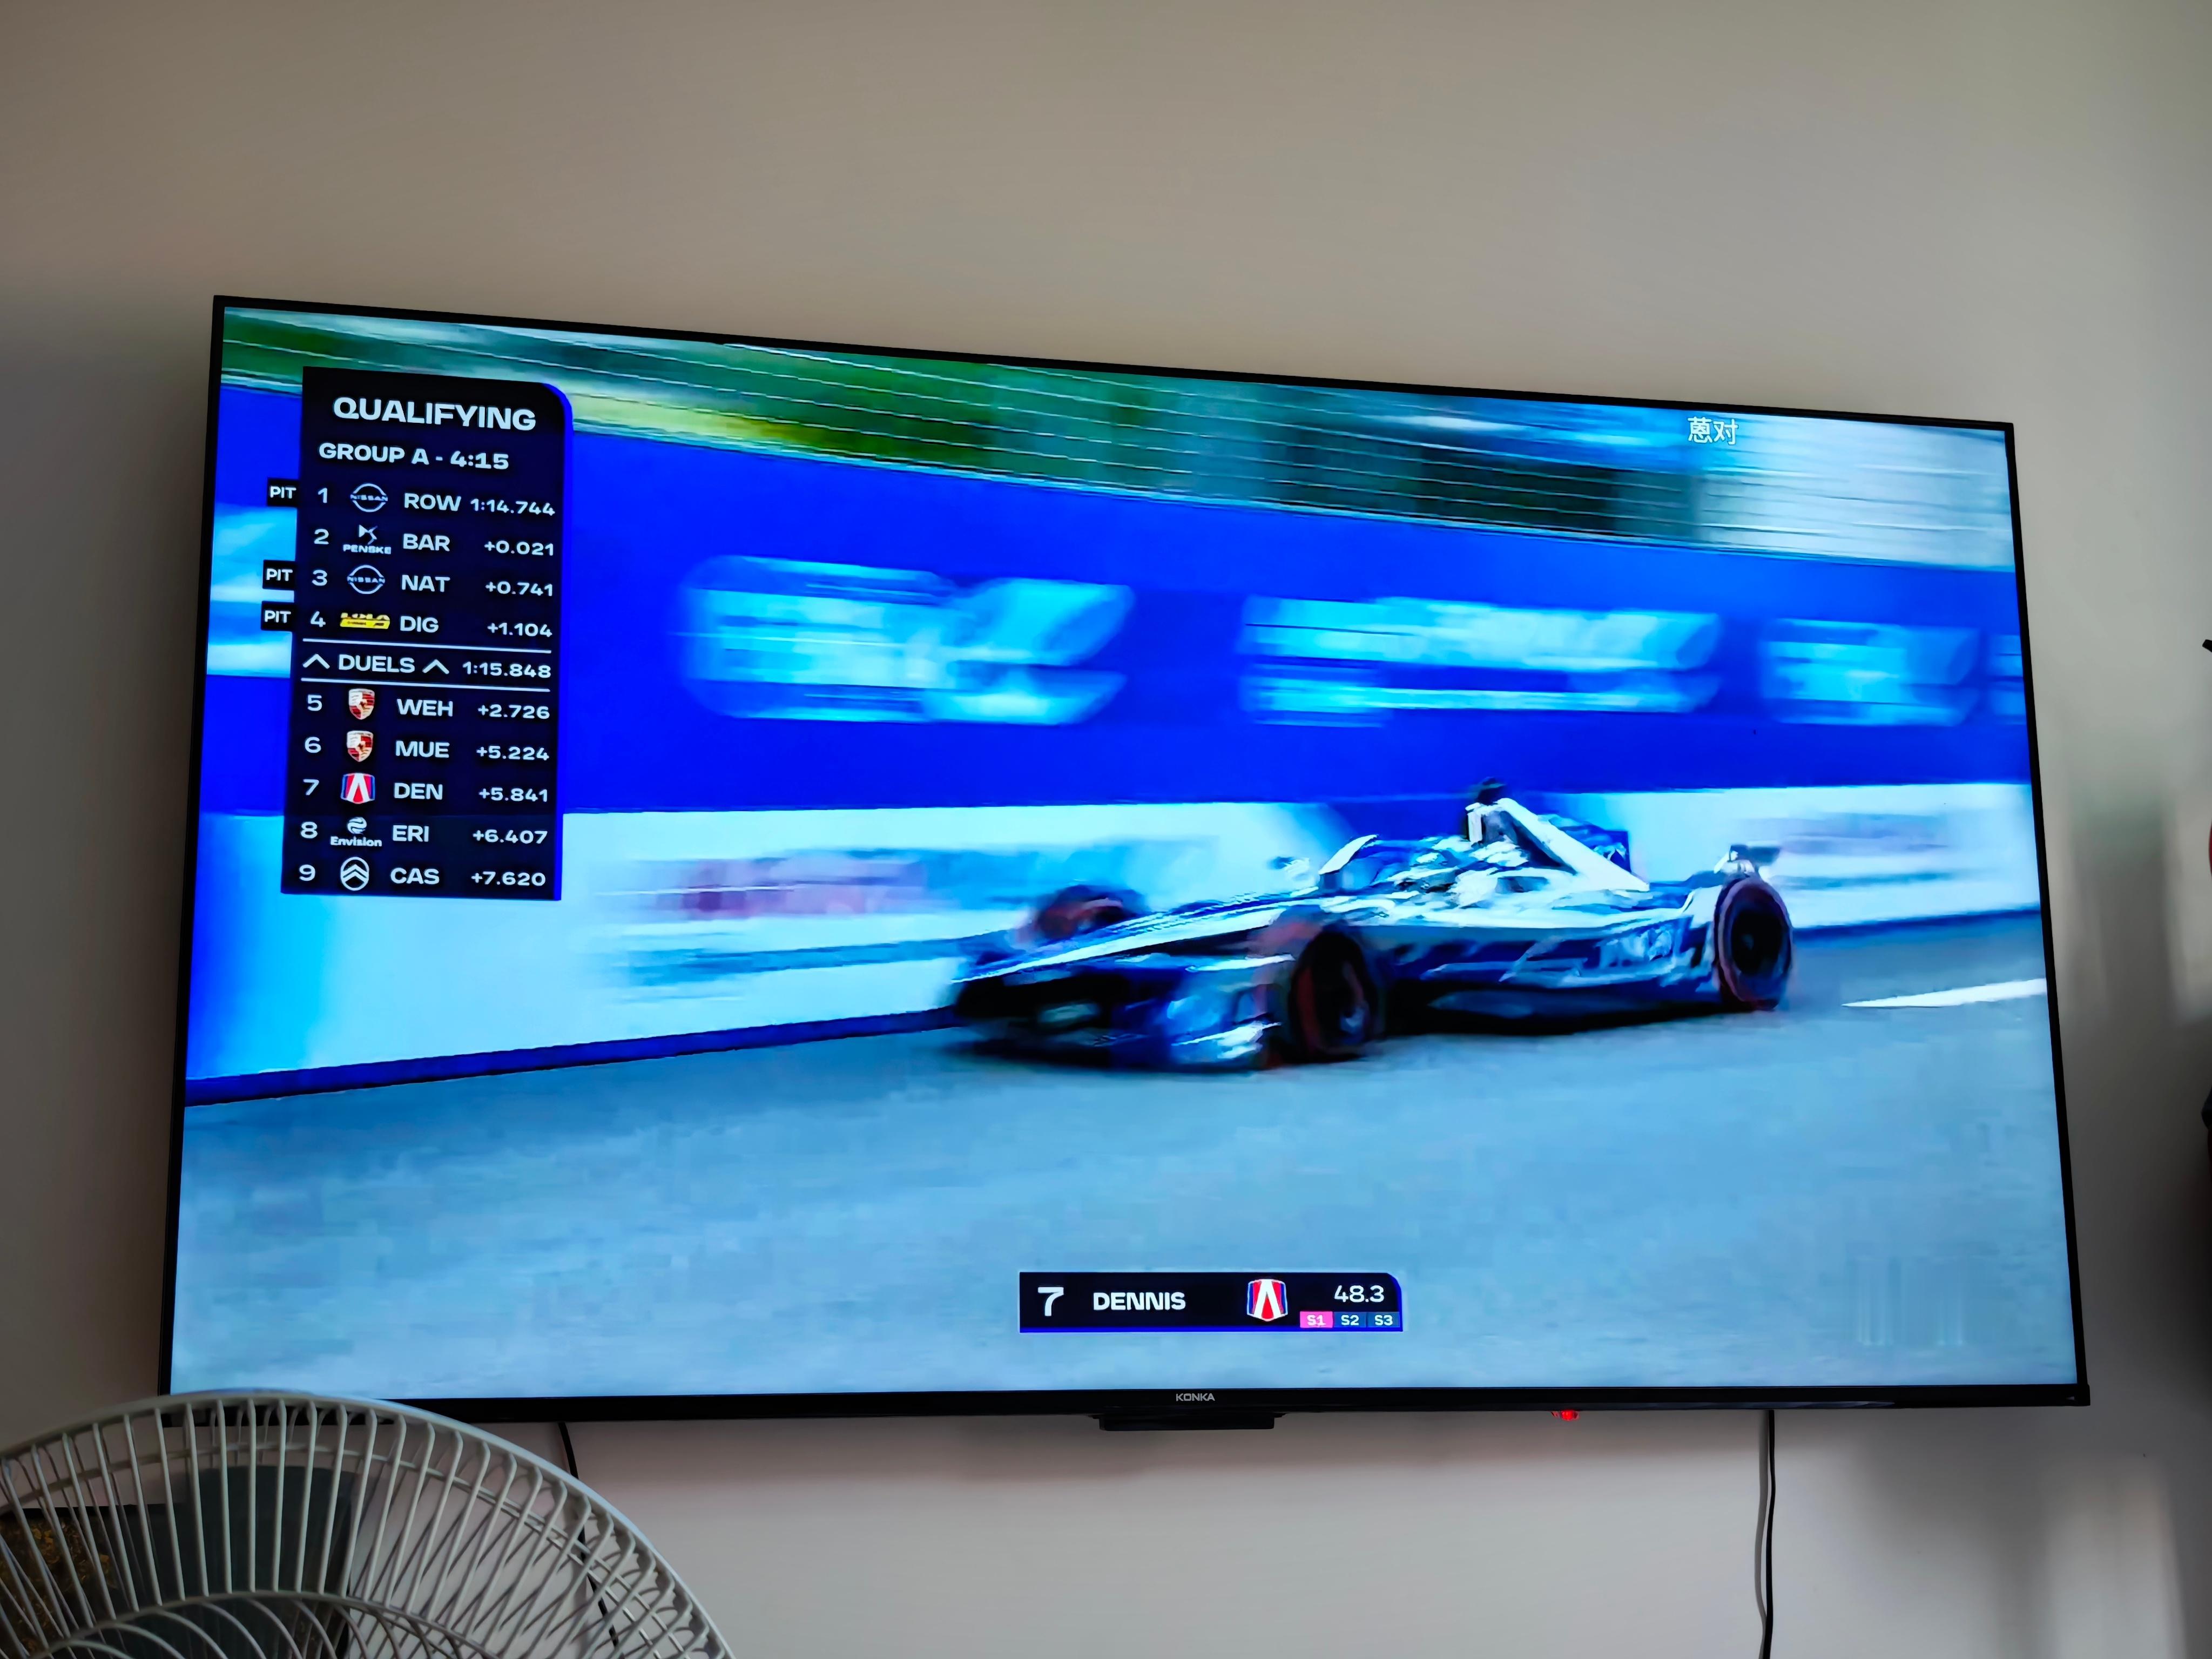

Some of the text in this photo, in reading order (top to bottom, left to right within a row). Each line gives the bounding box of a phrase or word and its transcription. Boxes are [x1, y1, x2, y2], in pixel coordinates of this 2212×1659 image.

[333, 396, 537, 431] QUALIFYING
[319, 442, 406, 463] GROUP
[411, 448, 429, 465] A
[449, 450, 509, 470] 4:15
[269, 485, 297, 500] PIT
[317, 487, 328, 503] 1
[403, 493, 462, 512] ROW
[470, 498, 556, 516] 1:14.744
[313, 528, 555, 557] 2 PENSKE BAR +0.021
[265, 568, 294, 582] PIT
[311, 569, 328, 587] 3
[401, 574, 451, 593] NAT
[485, 581, 554, 597] +0.741
[264, 610, 292, 624] PIT
[309, 611, 327, 628] 4
[400, 616, 440, 633] DIG
[487, 622, 553, 638] +1.104
[338, 654, 552, 678] DUELS 1:15.848
[307, 694, 551, 720] 5 WEH +2.726
[304, 736, 550, 761] 6 MUE +5.224
[302, 779, 549, 803] 7 DEN +5.841
[300, 821, 549, 848] 8 Envision ERI +6.407
[298, 864, 547, 887] 9 CAS +7.620
[1037, 1285, 1385, 1317] 7 DENNIS 48.3
[1306, 1314, 1394, 1327] S1 S2 S3
[1175, 1392, 1216, 1402] KONKA
